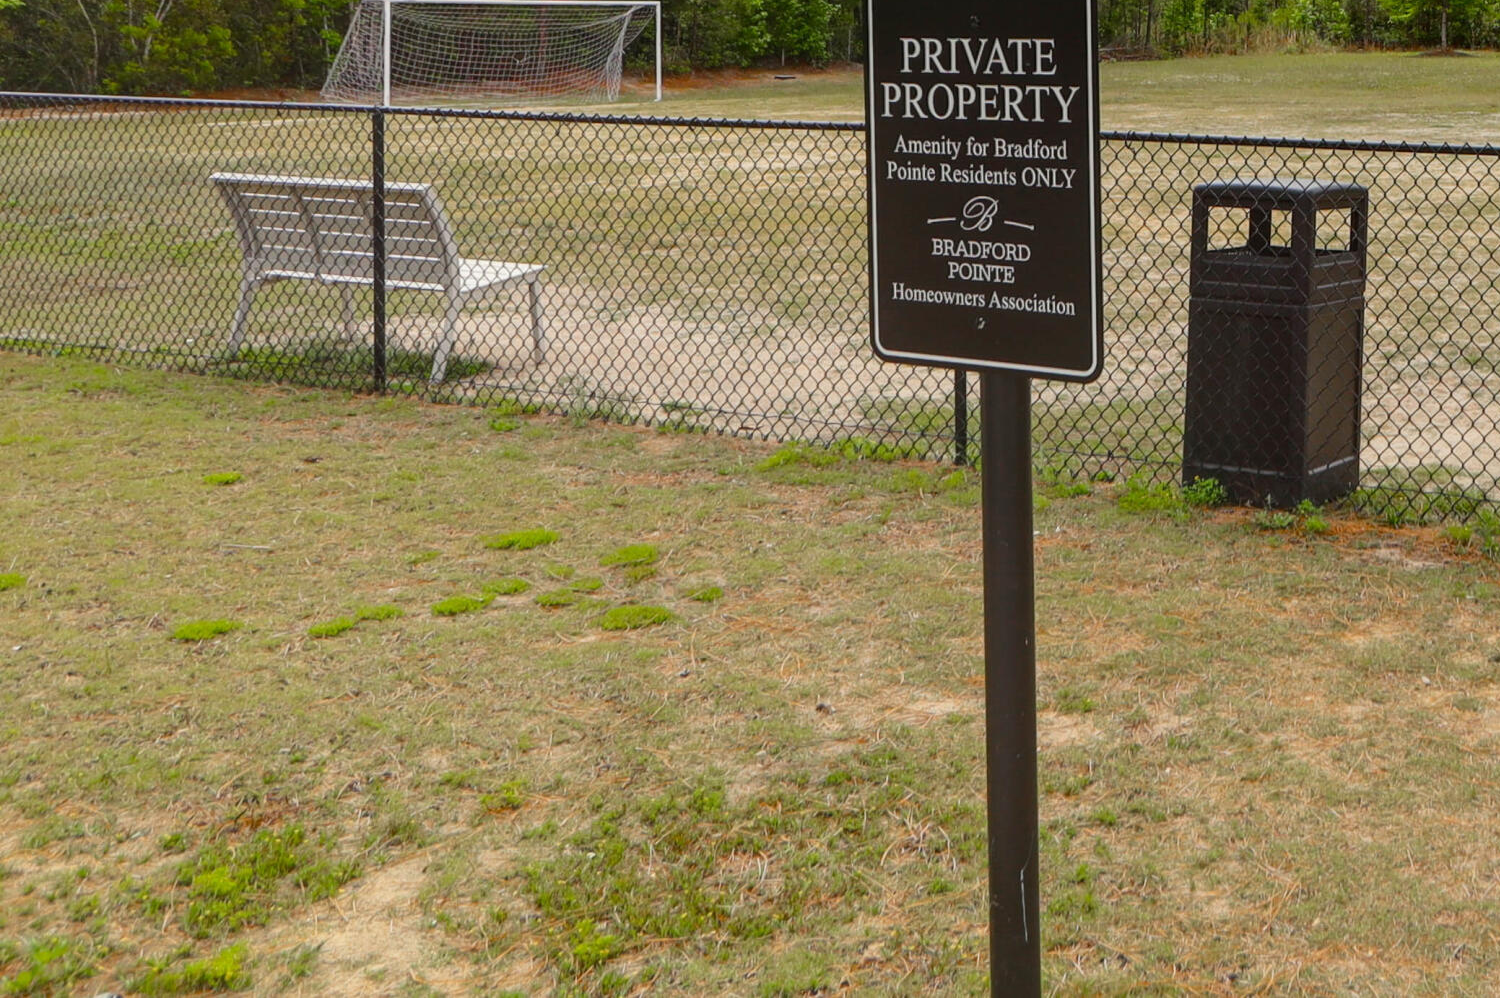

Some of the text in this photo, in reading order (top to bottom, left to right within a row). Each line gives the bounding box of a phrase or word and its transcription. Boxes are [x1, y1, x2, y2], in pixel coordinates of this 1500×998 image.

[900, 38, 1056, 75] PRIVATE
[881, 83, 1080, 122] PROPERTY
[894, 135, 1067, 160] Amenity for Bradford
[887, 161, 1076, 188] Pointe Residents ONLY
[960, 196, 998, 231] B
[932, 238, 1030, 261] BRADFORD
[948, 262, 1014, 283] POINTE
[892, 282, 1075, 315] Homeowners Association
